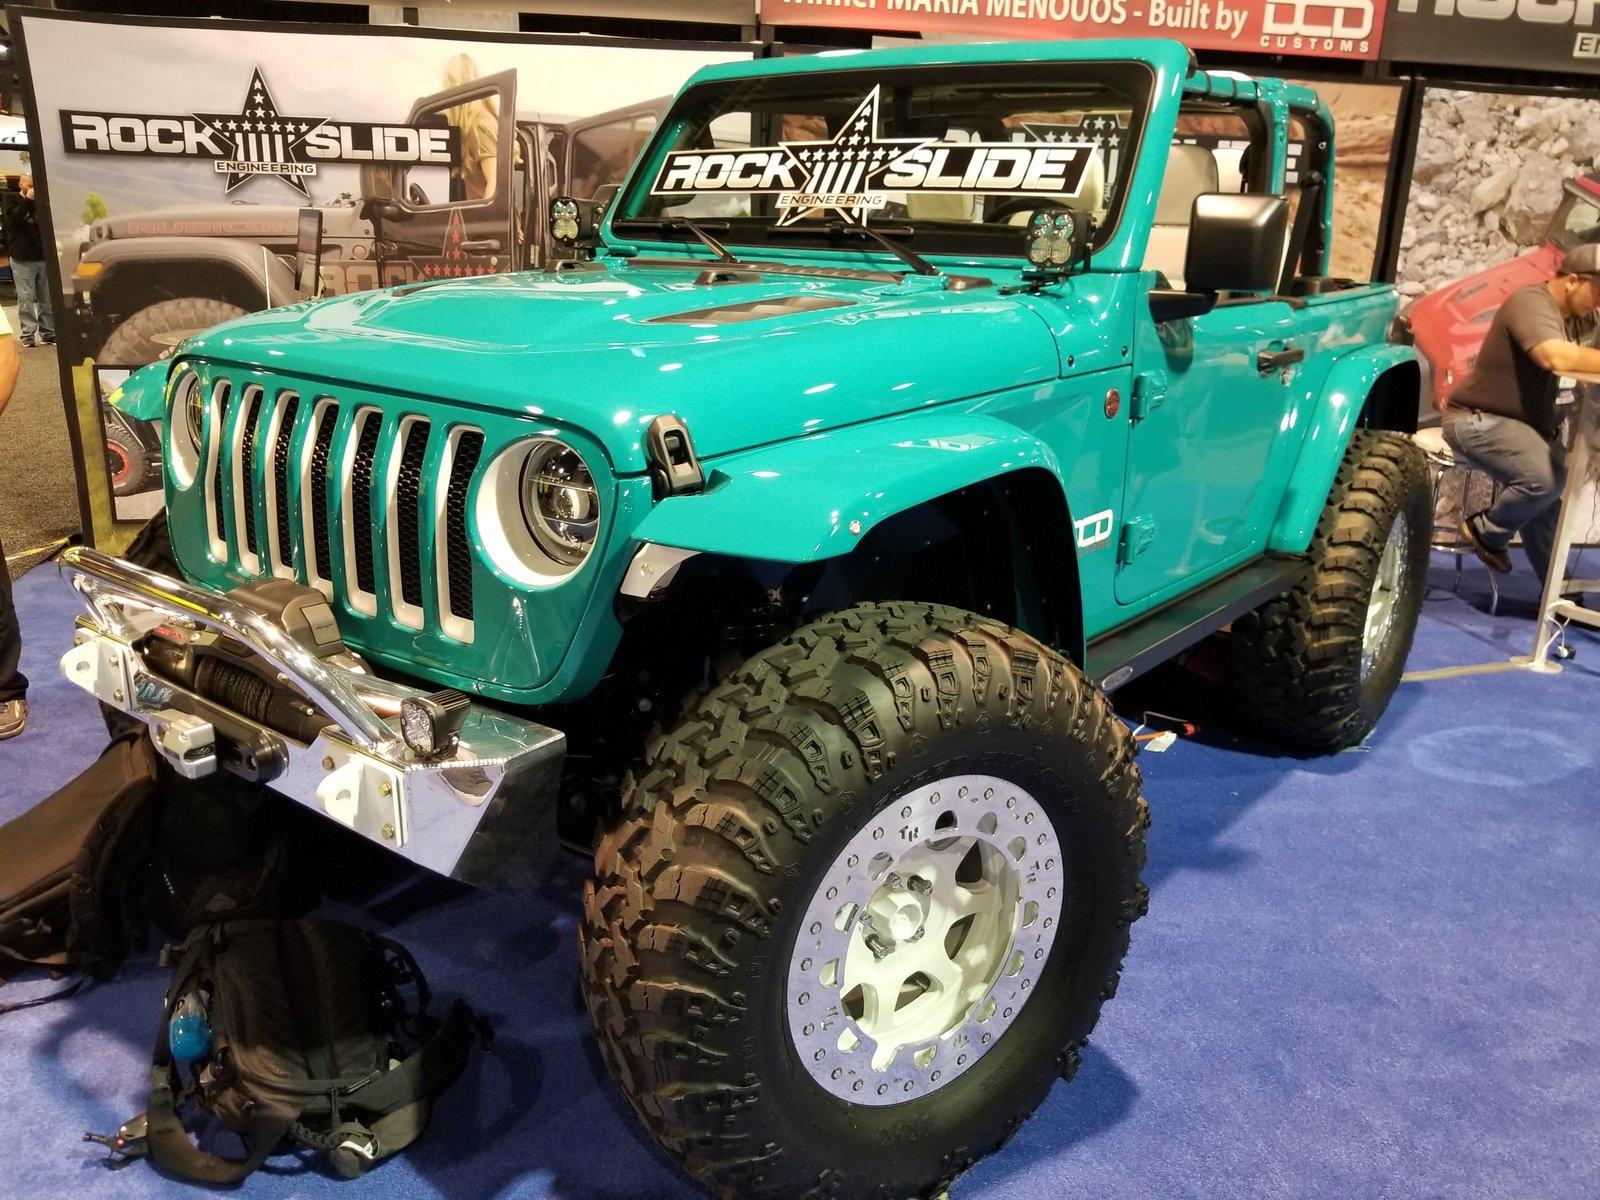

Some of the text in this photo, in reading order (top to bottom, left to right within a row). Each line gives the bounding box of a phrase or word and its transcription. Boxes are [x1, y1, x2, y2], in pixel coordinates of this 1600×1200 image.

[1148, 0, 1210, 30] Built
[1215, 0, 1248, 40] by
[1260, 35, 1369, 53] CUSTOMS
[70, 113, 452, 162] ROCK SLIDE
[216, 161, 315, 175] ENGINEERING
[662, 147, 1075, 190] ROCK SLIDE
[780, 194, 882, 205] ENGINEERING
